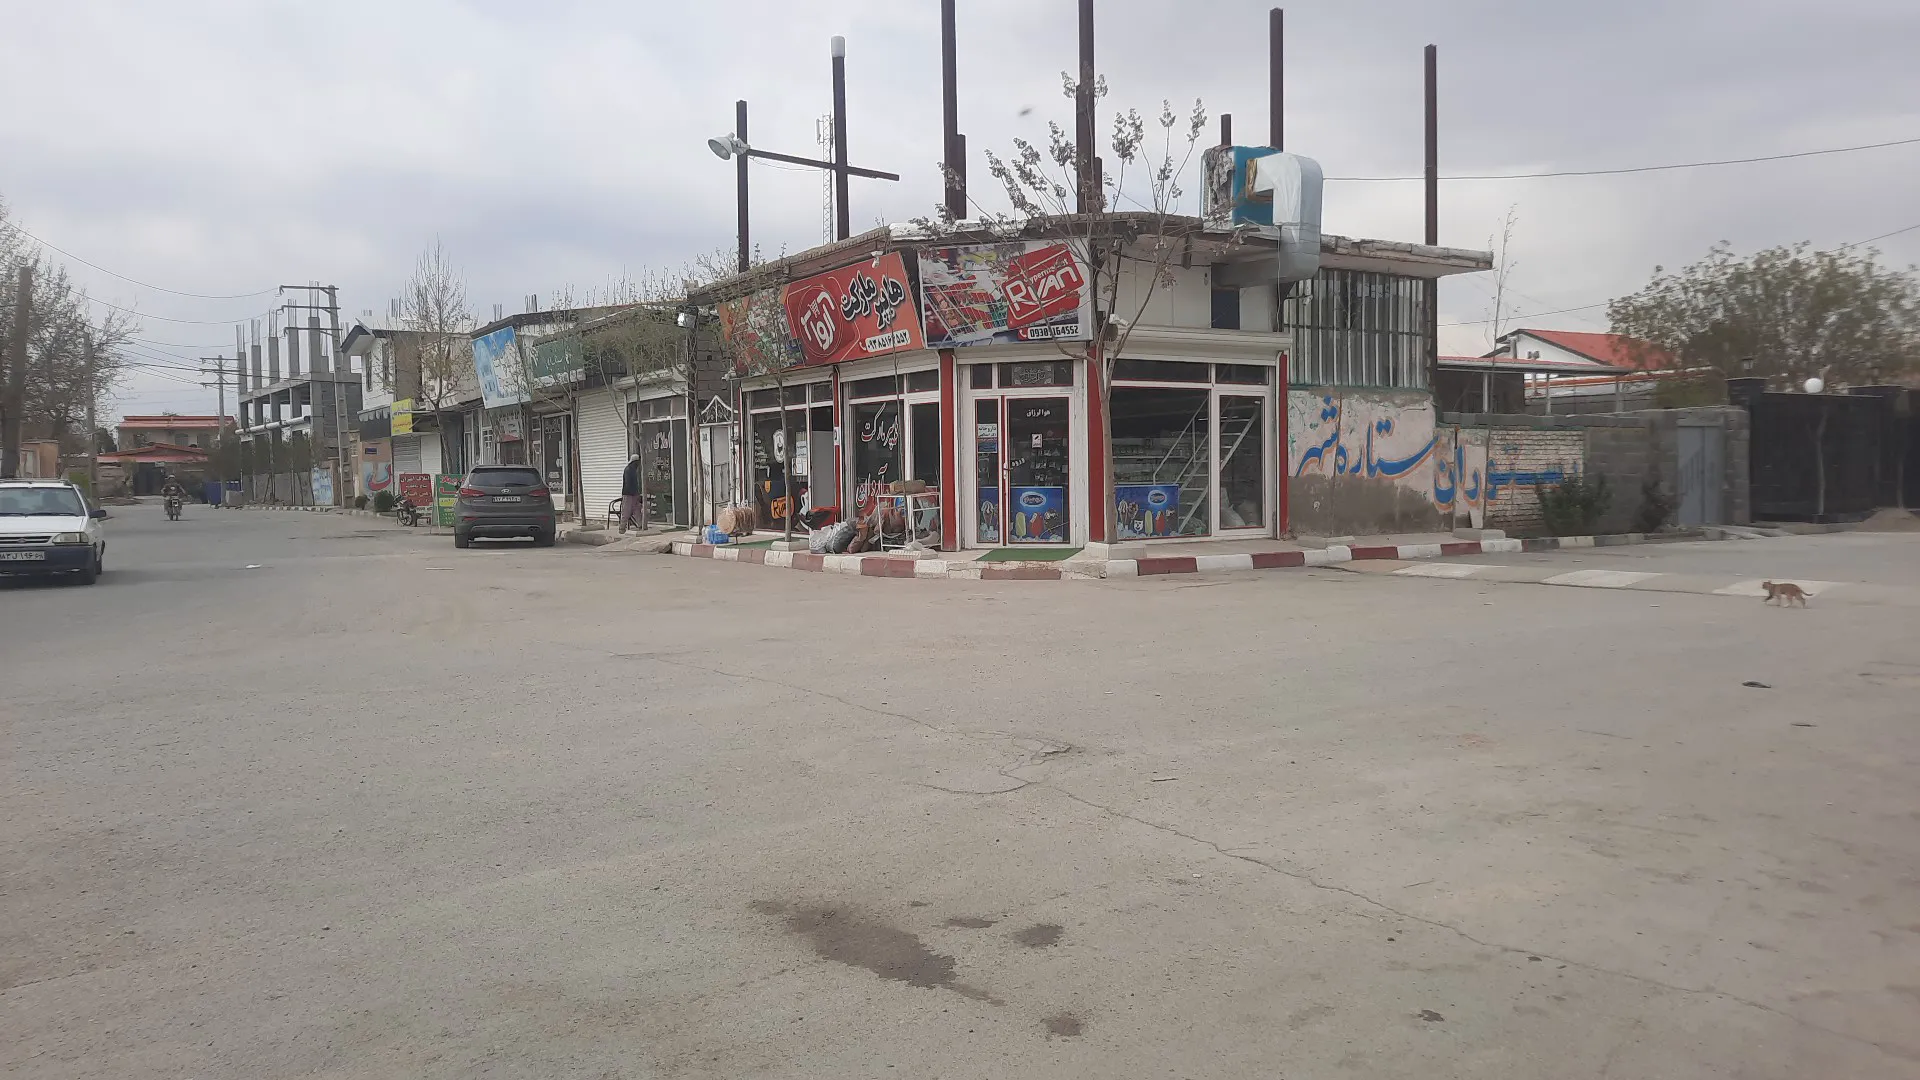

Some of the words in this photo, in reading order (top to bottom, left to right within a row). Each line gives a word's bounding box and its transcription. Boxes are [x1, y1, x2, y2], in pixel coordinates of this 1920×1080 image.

[840, 269, 877, 321] مارکت
[1029, 325, 1078, 337] 0938164552
[1295, 394, 1341, 478] شهر
[1336, 418, 1440, 478] ستاره
